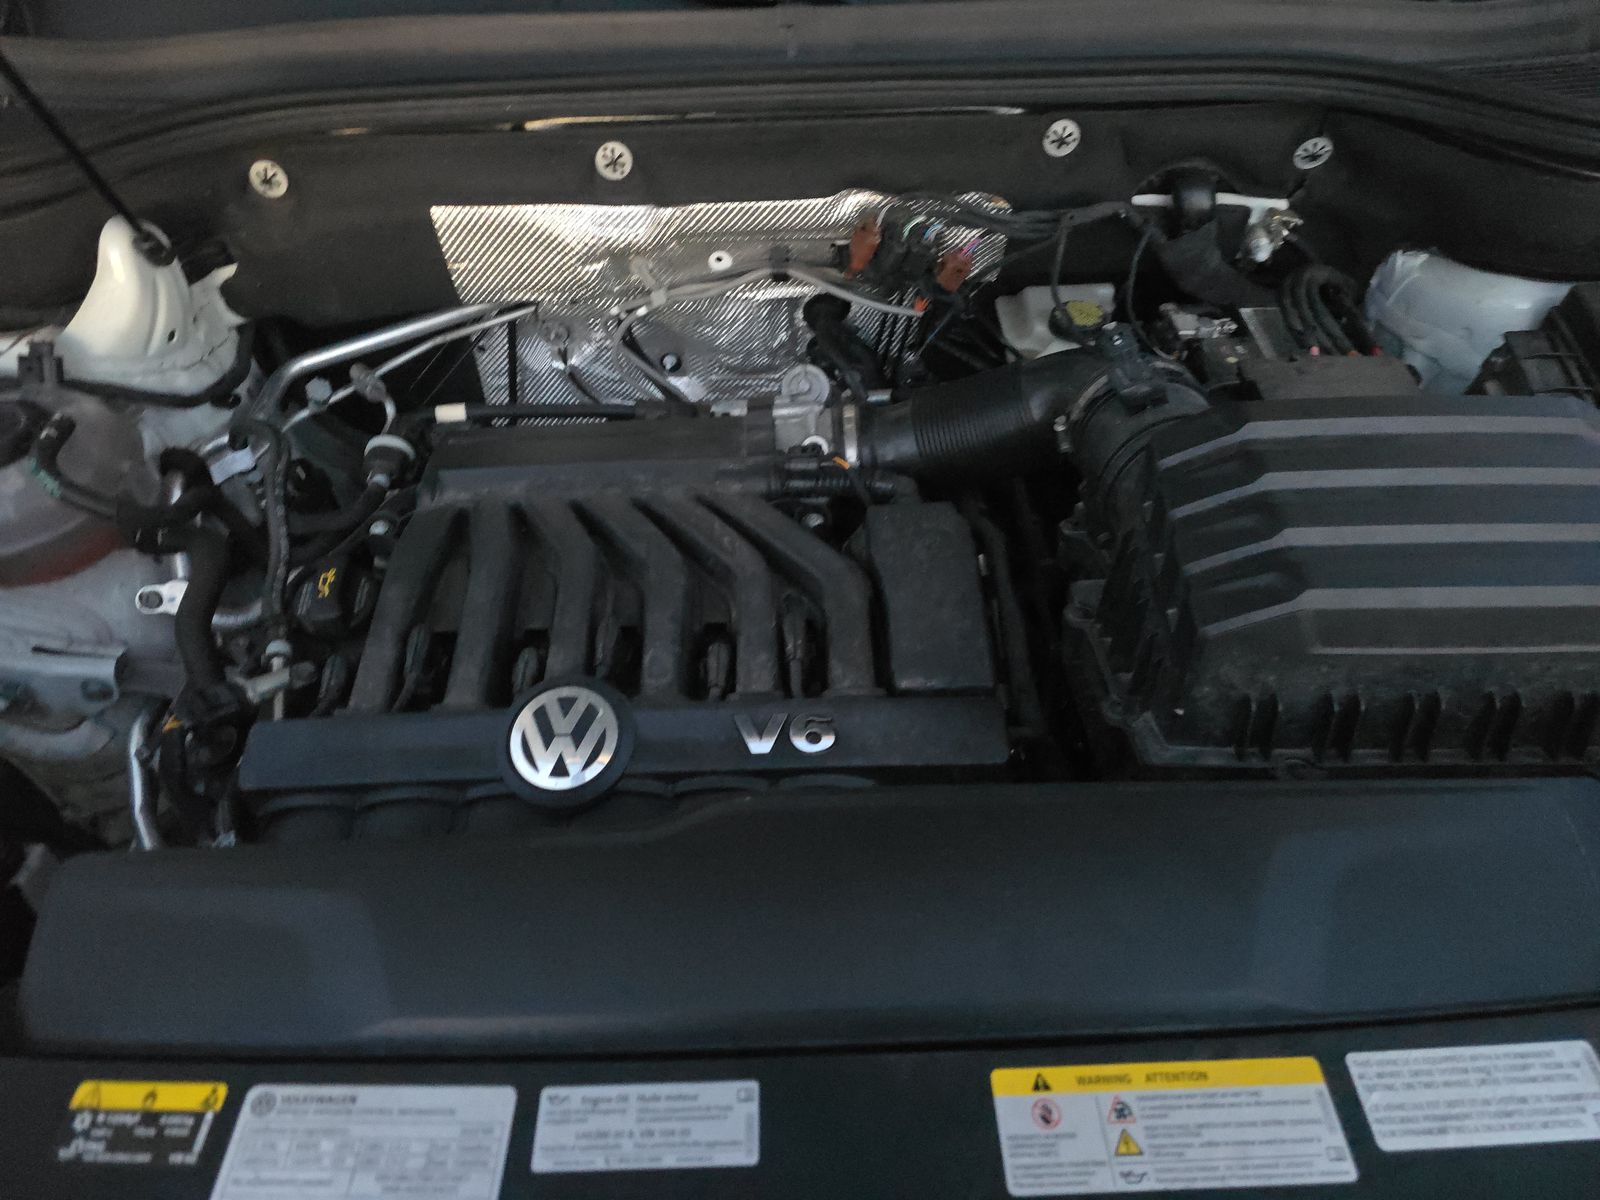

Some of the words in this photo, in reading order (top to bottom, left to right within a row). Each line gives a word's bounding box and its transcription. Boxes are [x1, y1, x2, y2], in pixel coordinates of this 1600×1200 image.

[734, 712, 836, 754] V6
[1076, 1073, 1132, 1085] WARNING
[1145, 1071, 1209, 1083] ATTENTION
